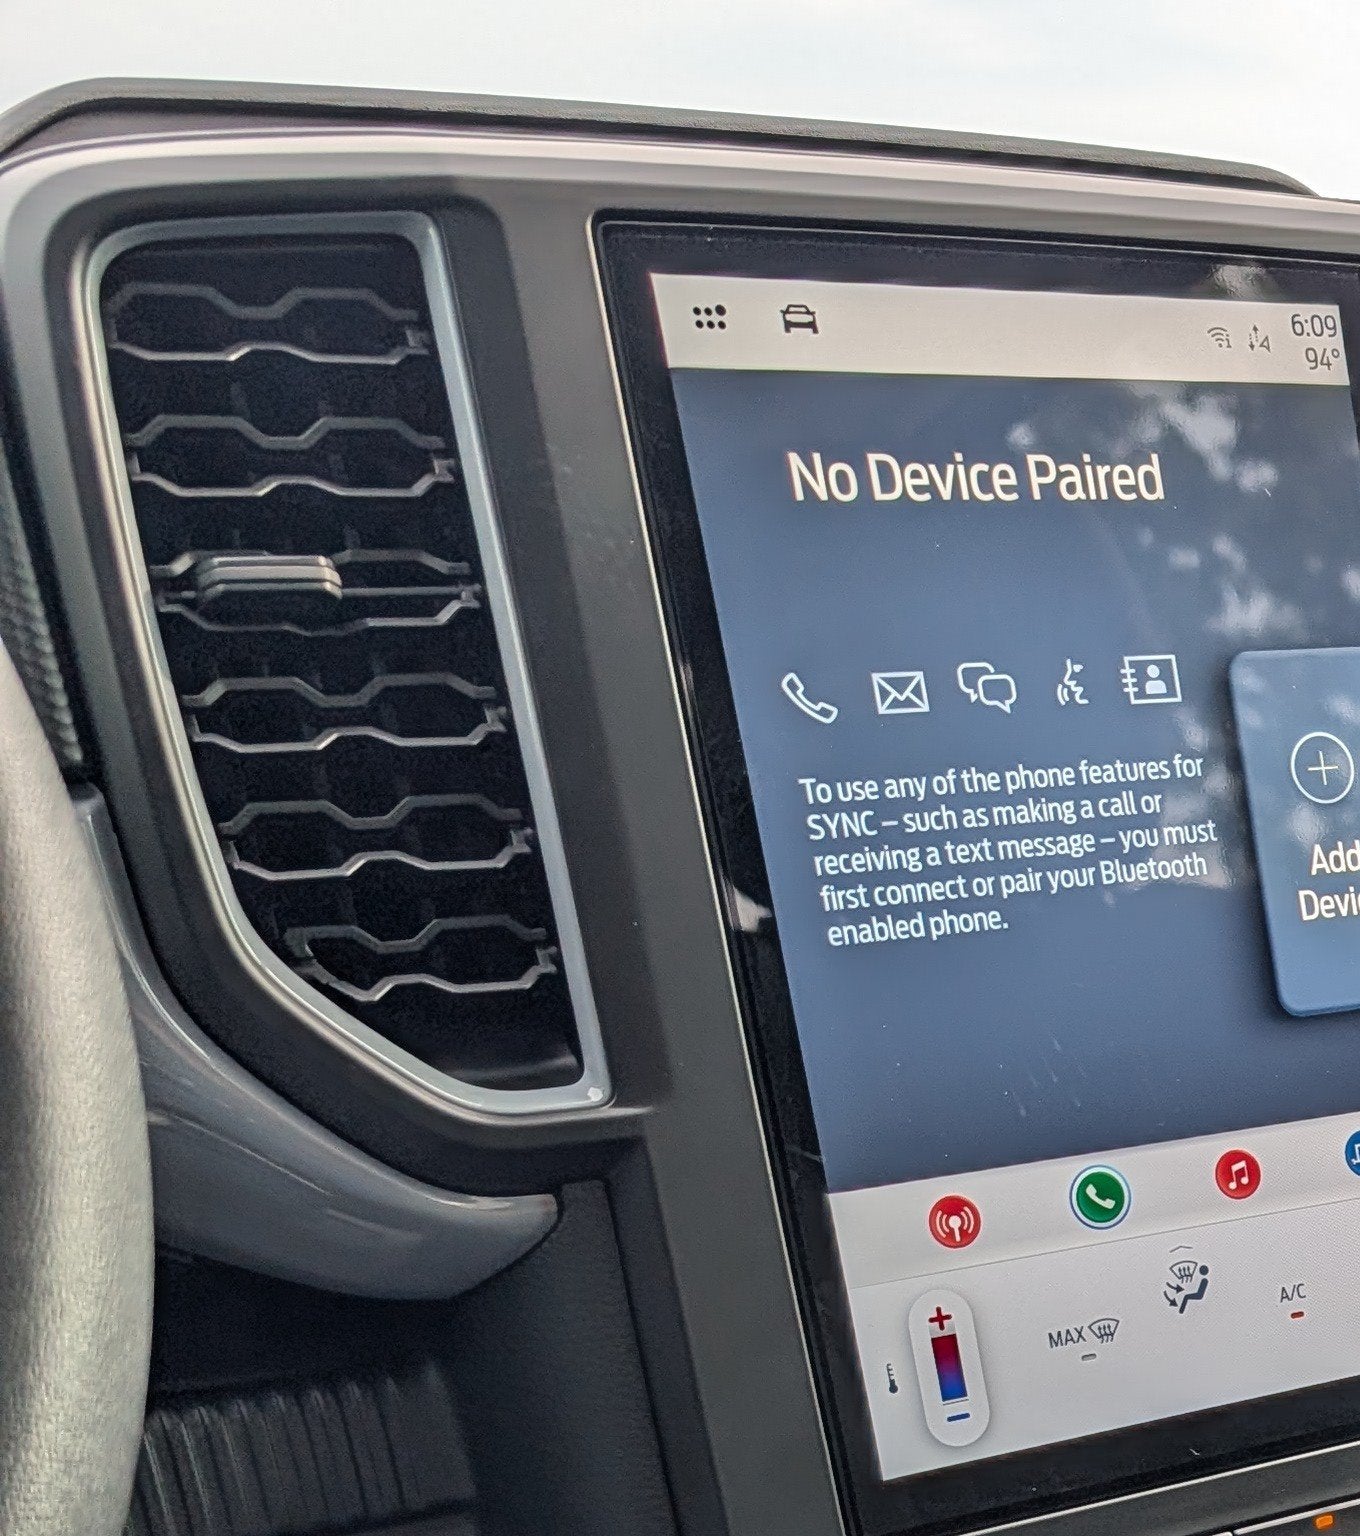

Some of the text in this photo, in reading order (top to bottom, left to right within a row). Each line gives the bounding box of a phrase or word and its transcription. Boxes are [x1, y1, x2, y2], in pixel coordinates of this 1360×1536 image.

[1291, 314, 1338, 338] 6:09
[786, 450, 1165, 503] No Device Paired
[799, 753, 1204, 805] To use any of the phone features for
[806, 810, 878, 841] SYNC
[902, 804, 958, 833] such
[962, 807, 989, 828] as
[993, 798, 1076, 828] making
[1080, 799, 1095, 818] a
[1098, 791, 1138, 817] call
[1140, 793, 1162, 814] or
[813, 844, 923, 877] receiving
[926, 846, 942, 866] a
[945, 837, 994, 865] text
[997, 832, 1096, 861] message
[1118, 827, 1160, 854] you
[1162, 819, 1218, 845] must
[820, 852, 1208, 912] first connect or pair your Bluetooth
[827, 908, 1009, 947] enabled phone.
[1279, 1283, 1307, 1303] A/C
[1047, 1325, 1086, 1349] MAX
